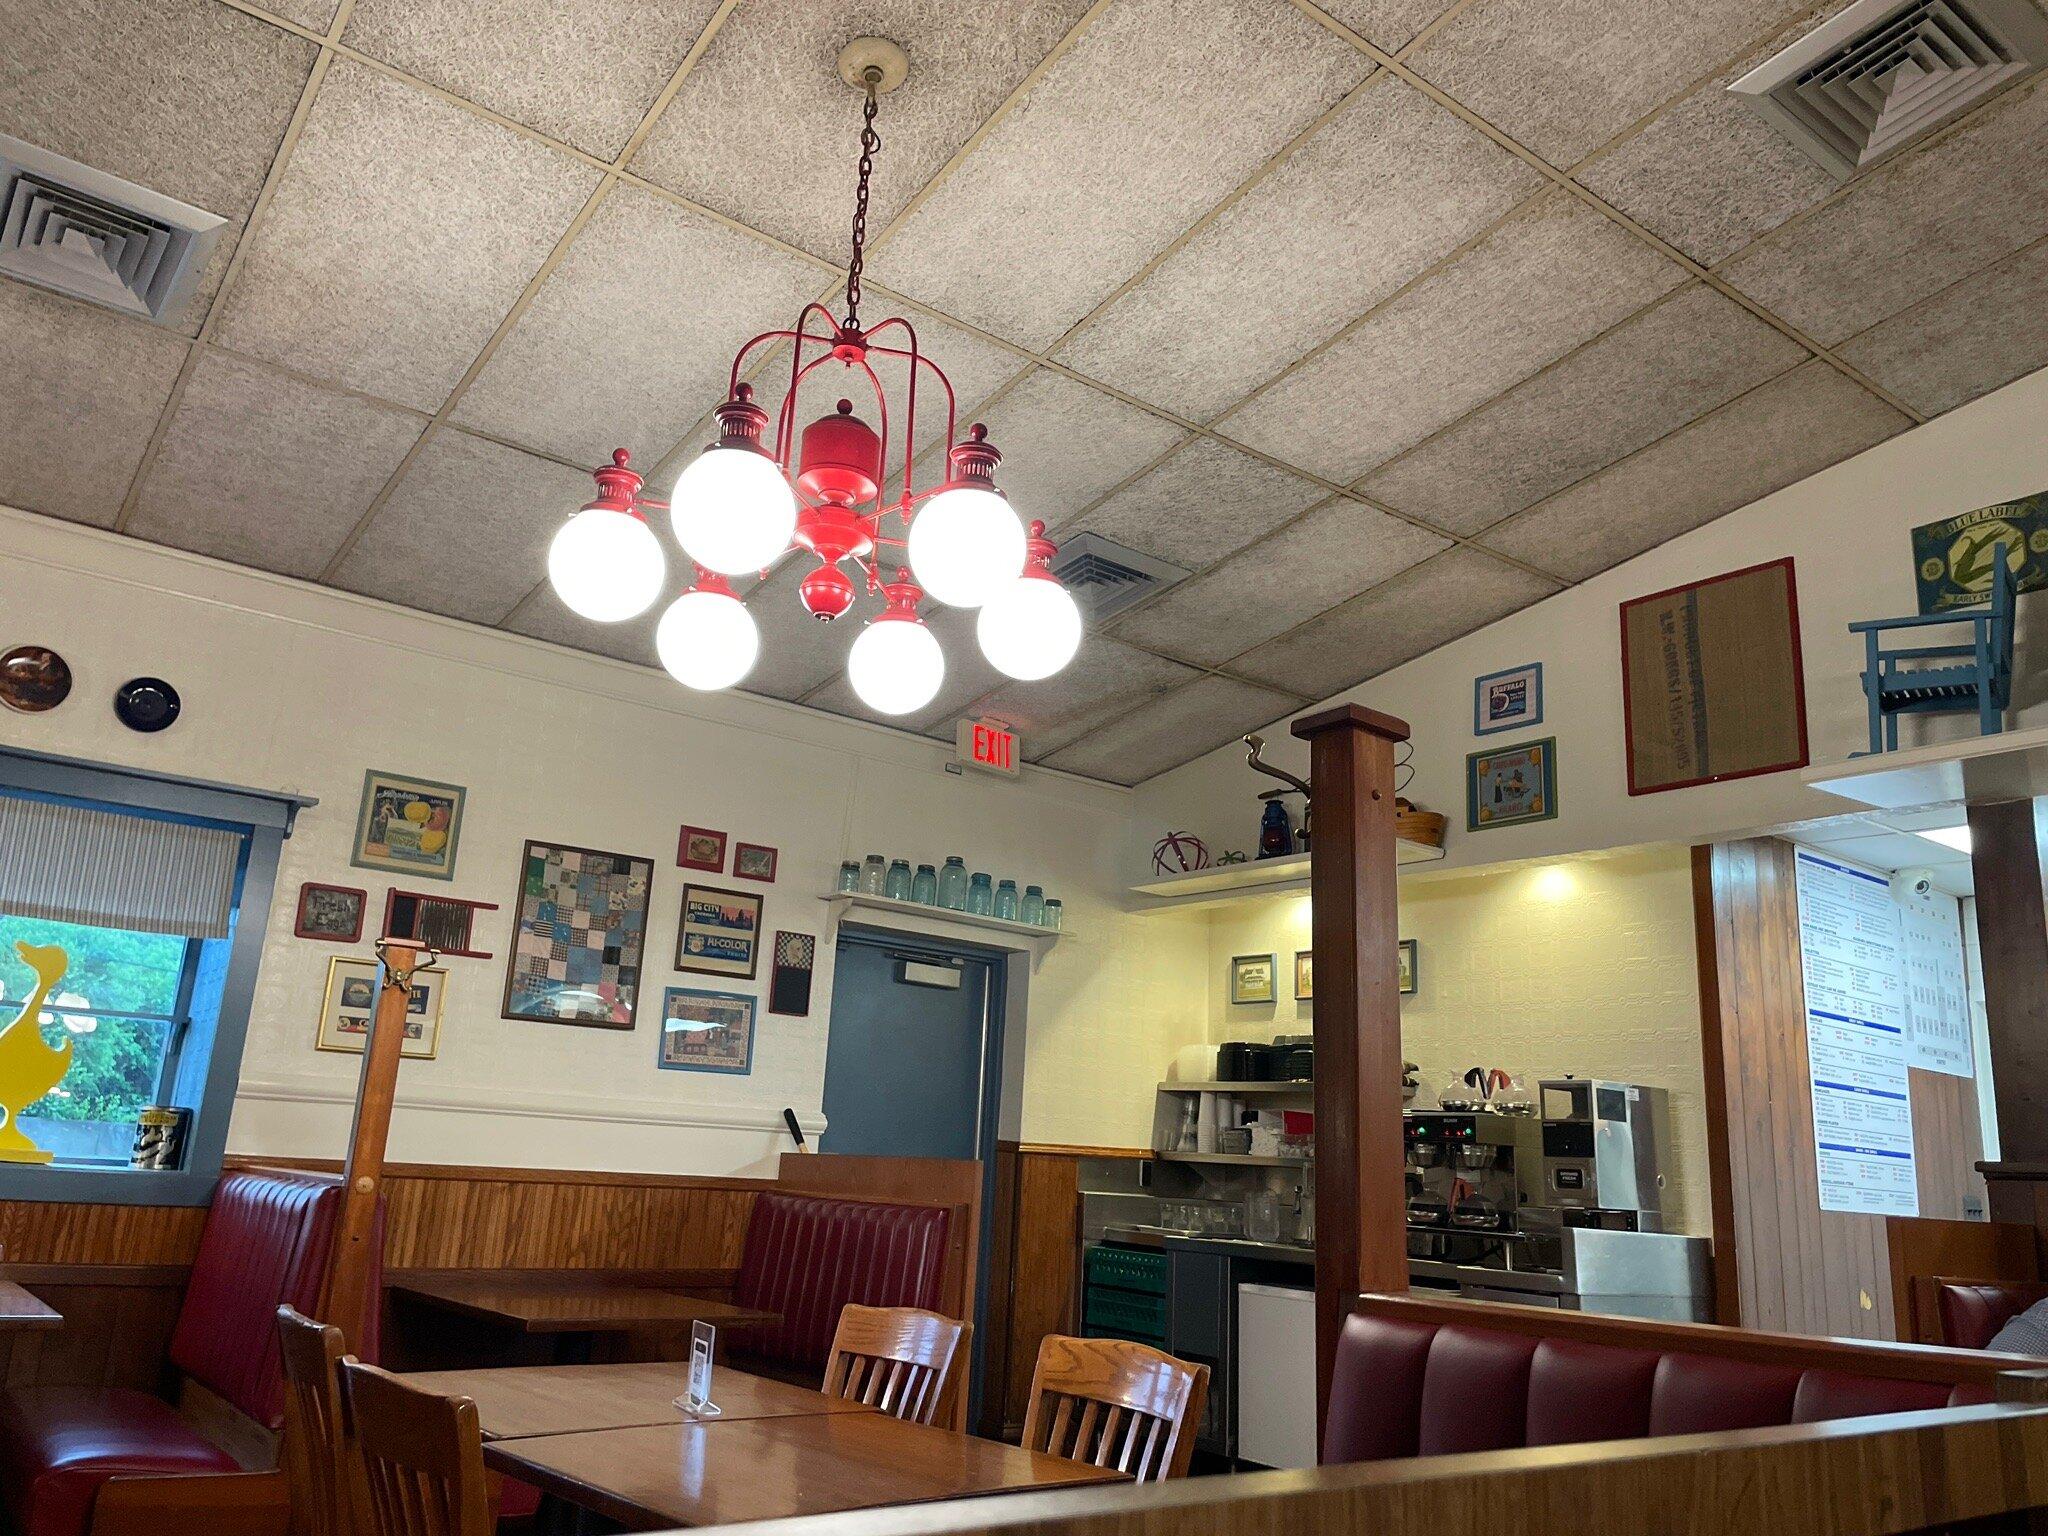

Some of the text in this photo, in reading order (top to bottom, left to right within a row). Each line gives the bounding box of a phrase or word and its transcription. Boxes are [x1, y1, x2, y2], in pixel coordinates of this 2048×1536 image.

[1947, 513, 1976, 533] BLUE
[1954, 593, 1978, 603] EARLY
[1491, 681, 1525, 697] BUFFALO
[973, 725, 1011, 769] EXIT
[312, 894, 351, 911] Fresh
[690, 902, 720, 913] BIG CITY
[707, 937, 748, 953] HI-COLOR
